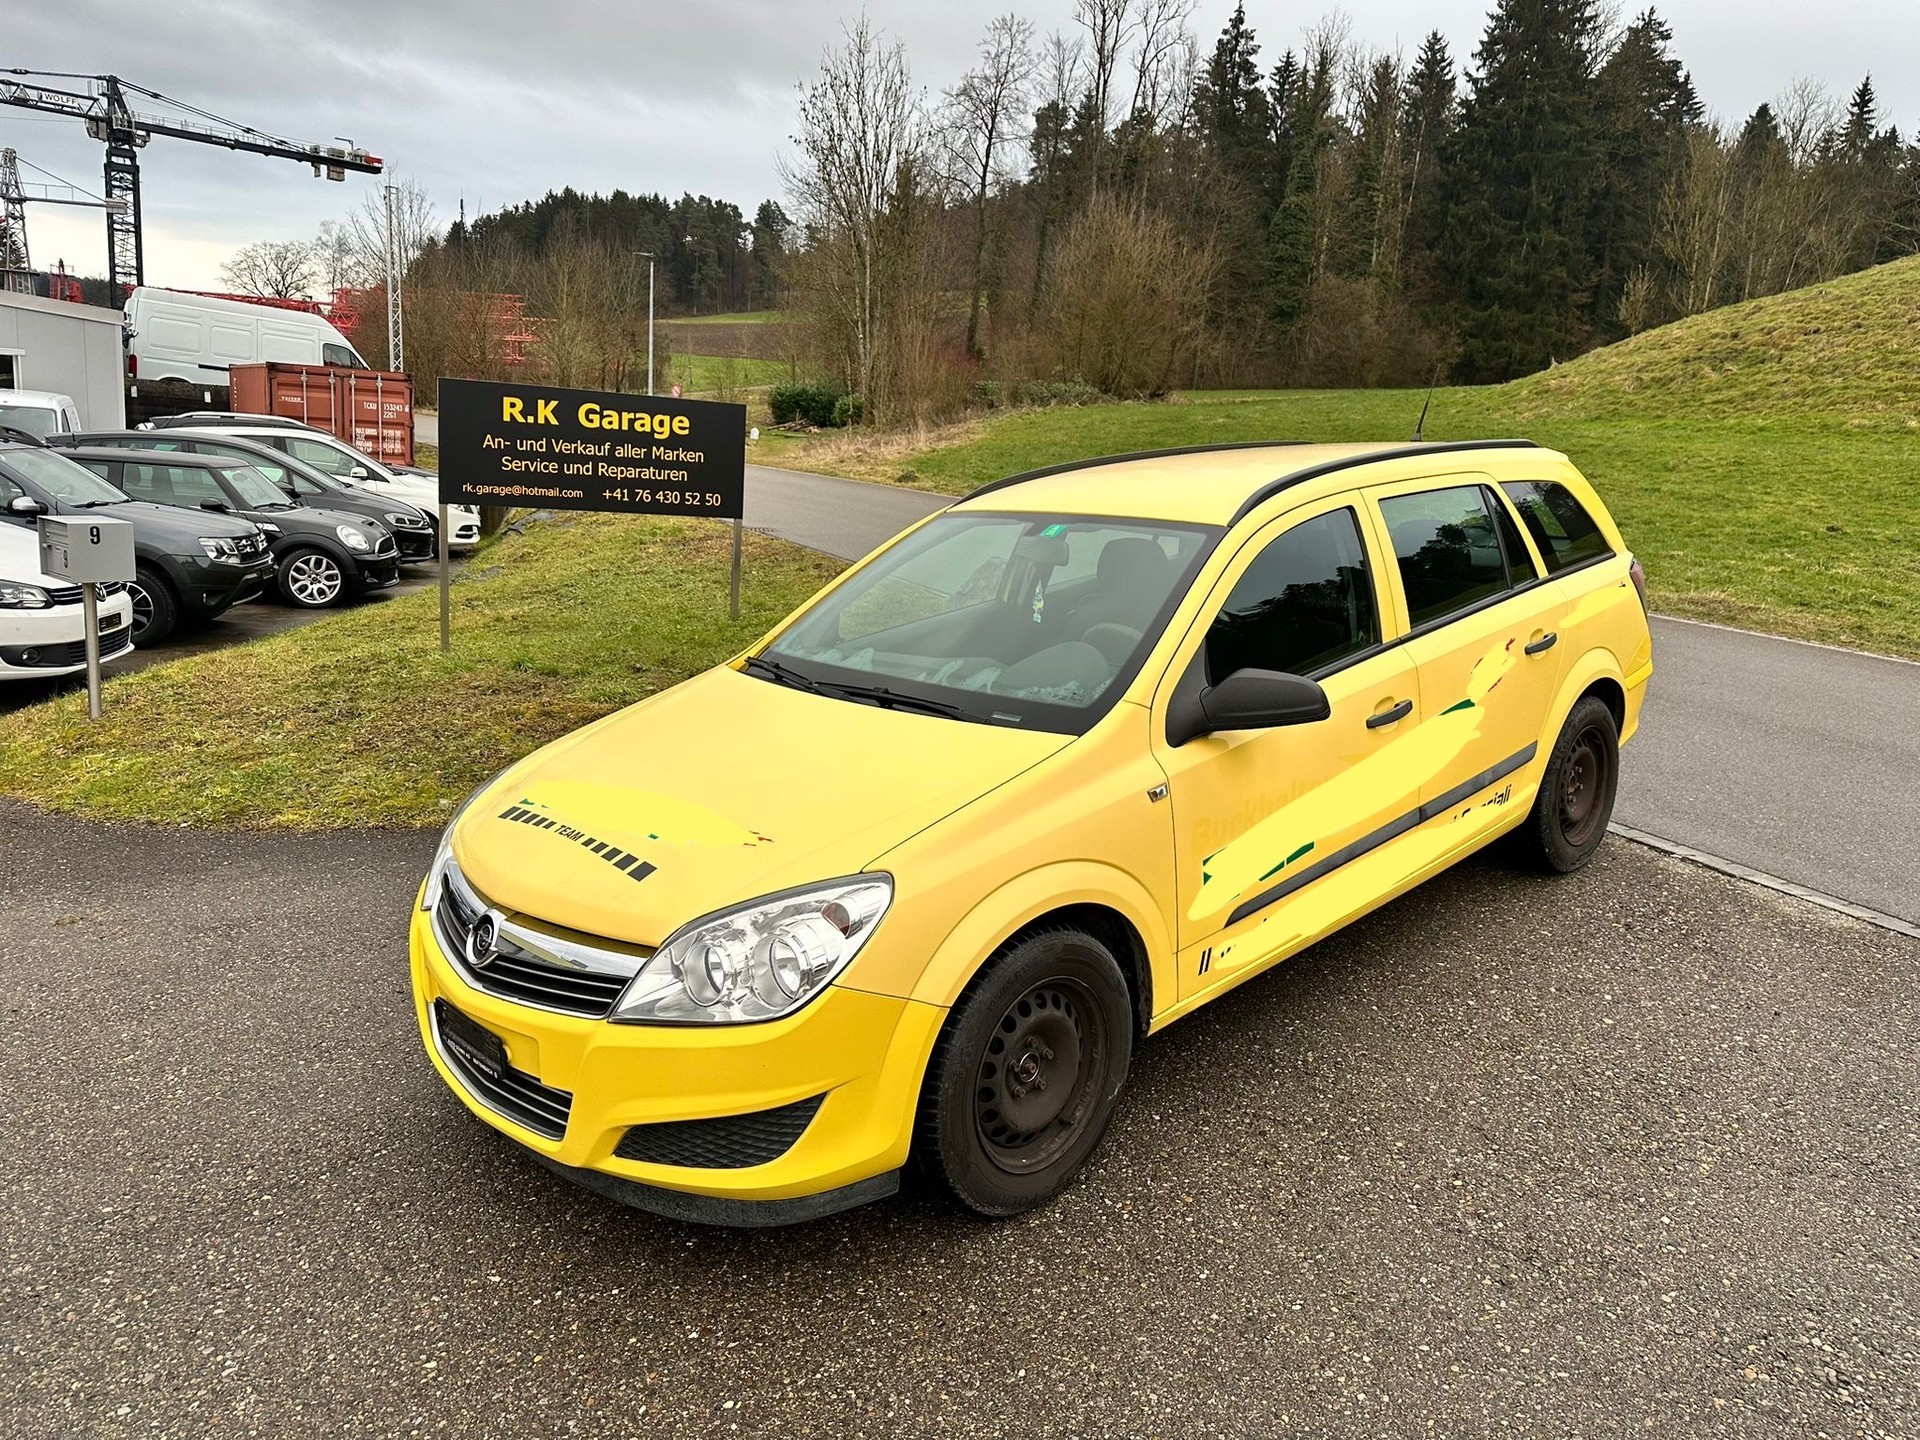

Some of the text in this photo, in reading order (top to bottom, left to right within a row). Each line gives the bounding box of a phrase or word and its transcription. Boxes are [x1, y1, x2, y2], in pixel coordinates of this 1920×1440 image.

[44, 92, 77, 105] WOLFF
[383, 403, 403, 412] 153243
[502, 396, 690, 440] R.K Garage
[482, 434, 705, 463] An- und Verkauf aller Marken
[501, 456, 688, 482] Service und Reparaturen
[462, 482, 584, 499] rk.garage@hotmail.com
[602, 488, 721, 507] +41 76 430 52 50
[89, 525, 101, 545] 9
[63, 549, 69, 569] 9
[553, 824, 586, 842] TEAM
